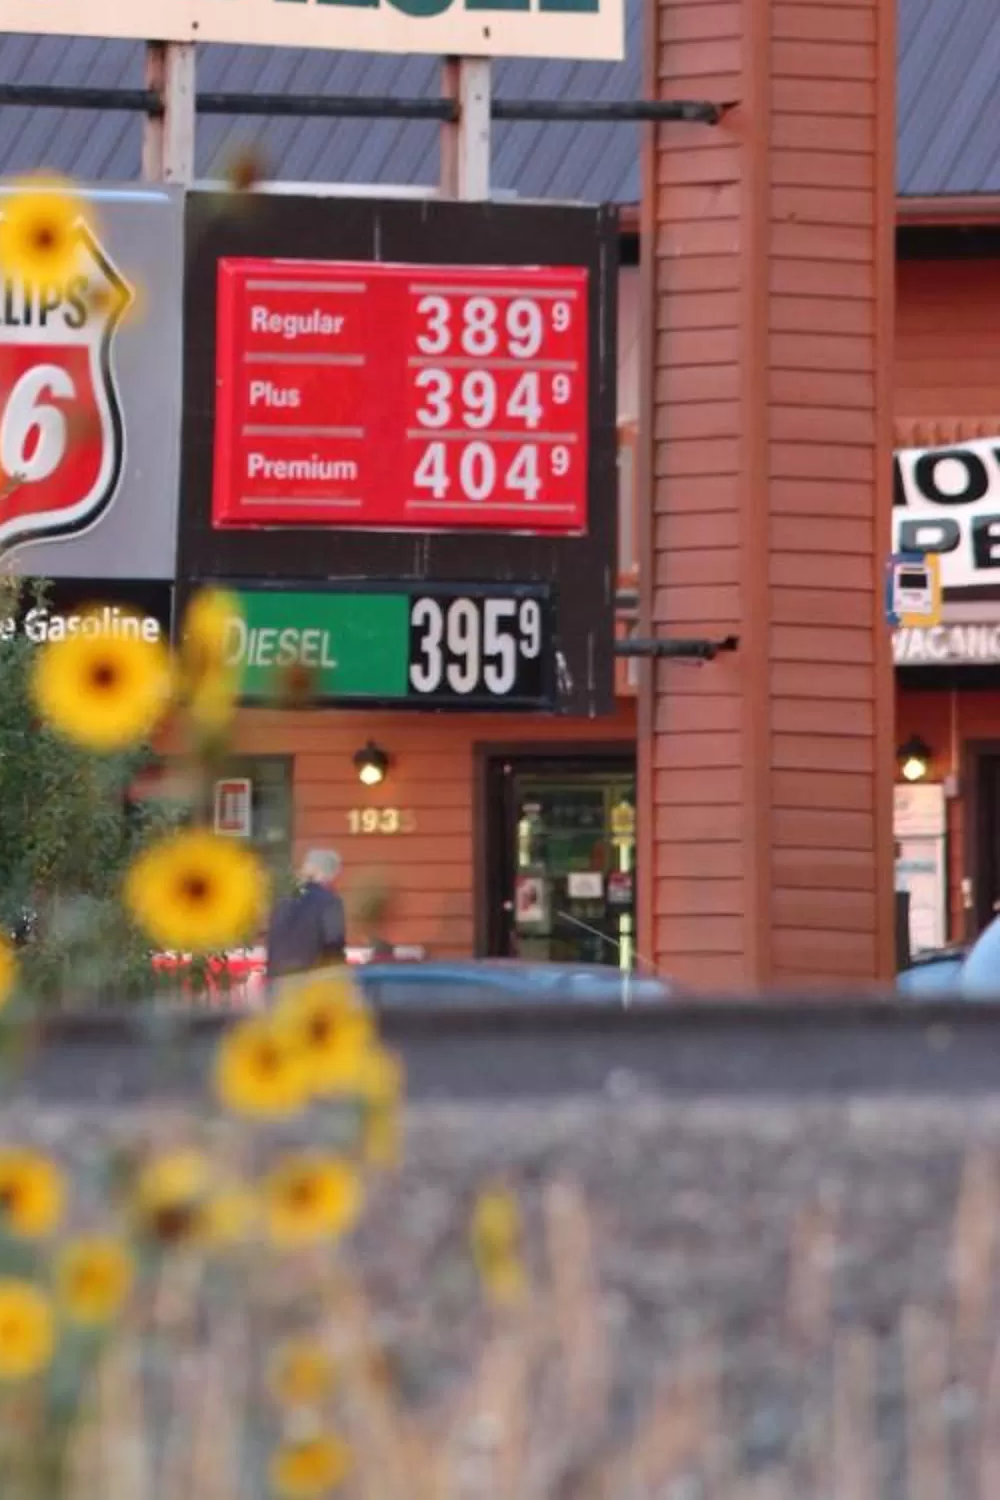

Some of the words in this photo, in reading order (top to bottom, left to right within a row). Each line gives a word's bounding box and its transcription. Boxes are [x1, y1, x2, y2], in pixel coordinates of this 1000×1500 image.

[250, 306, 345, 338] Regular
[249, 382, 300, 408] Plus
[247, 452, 358, 481] Premium
[24, 606, 161, 643] Gasoline
